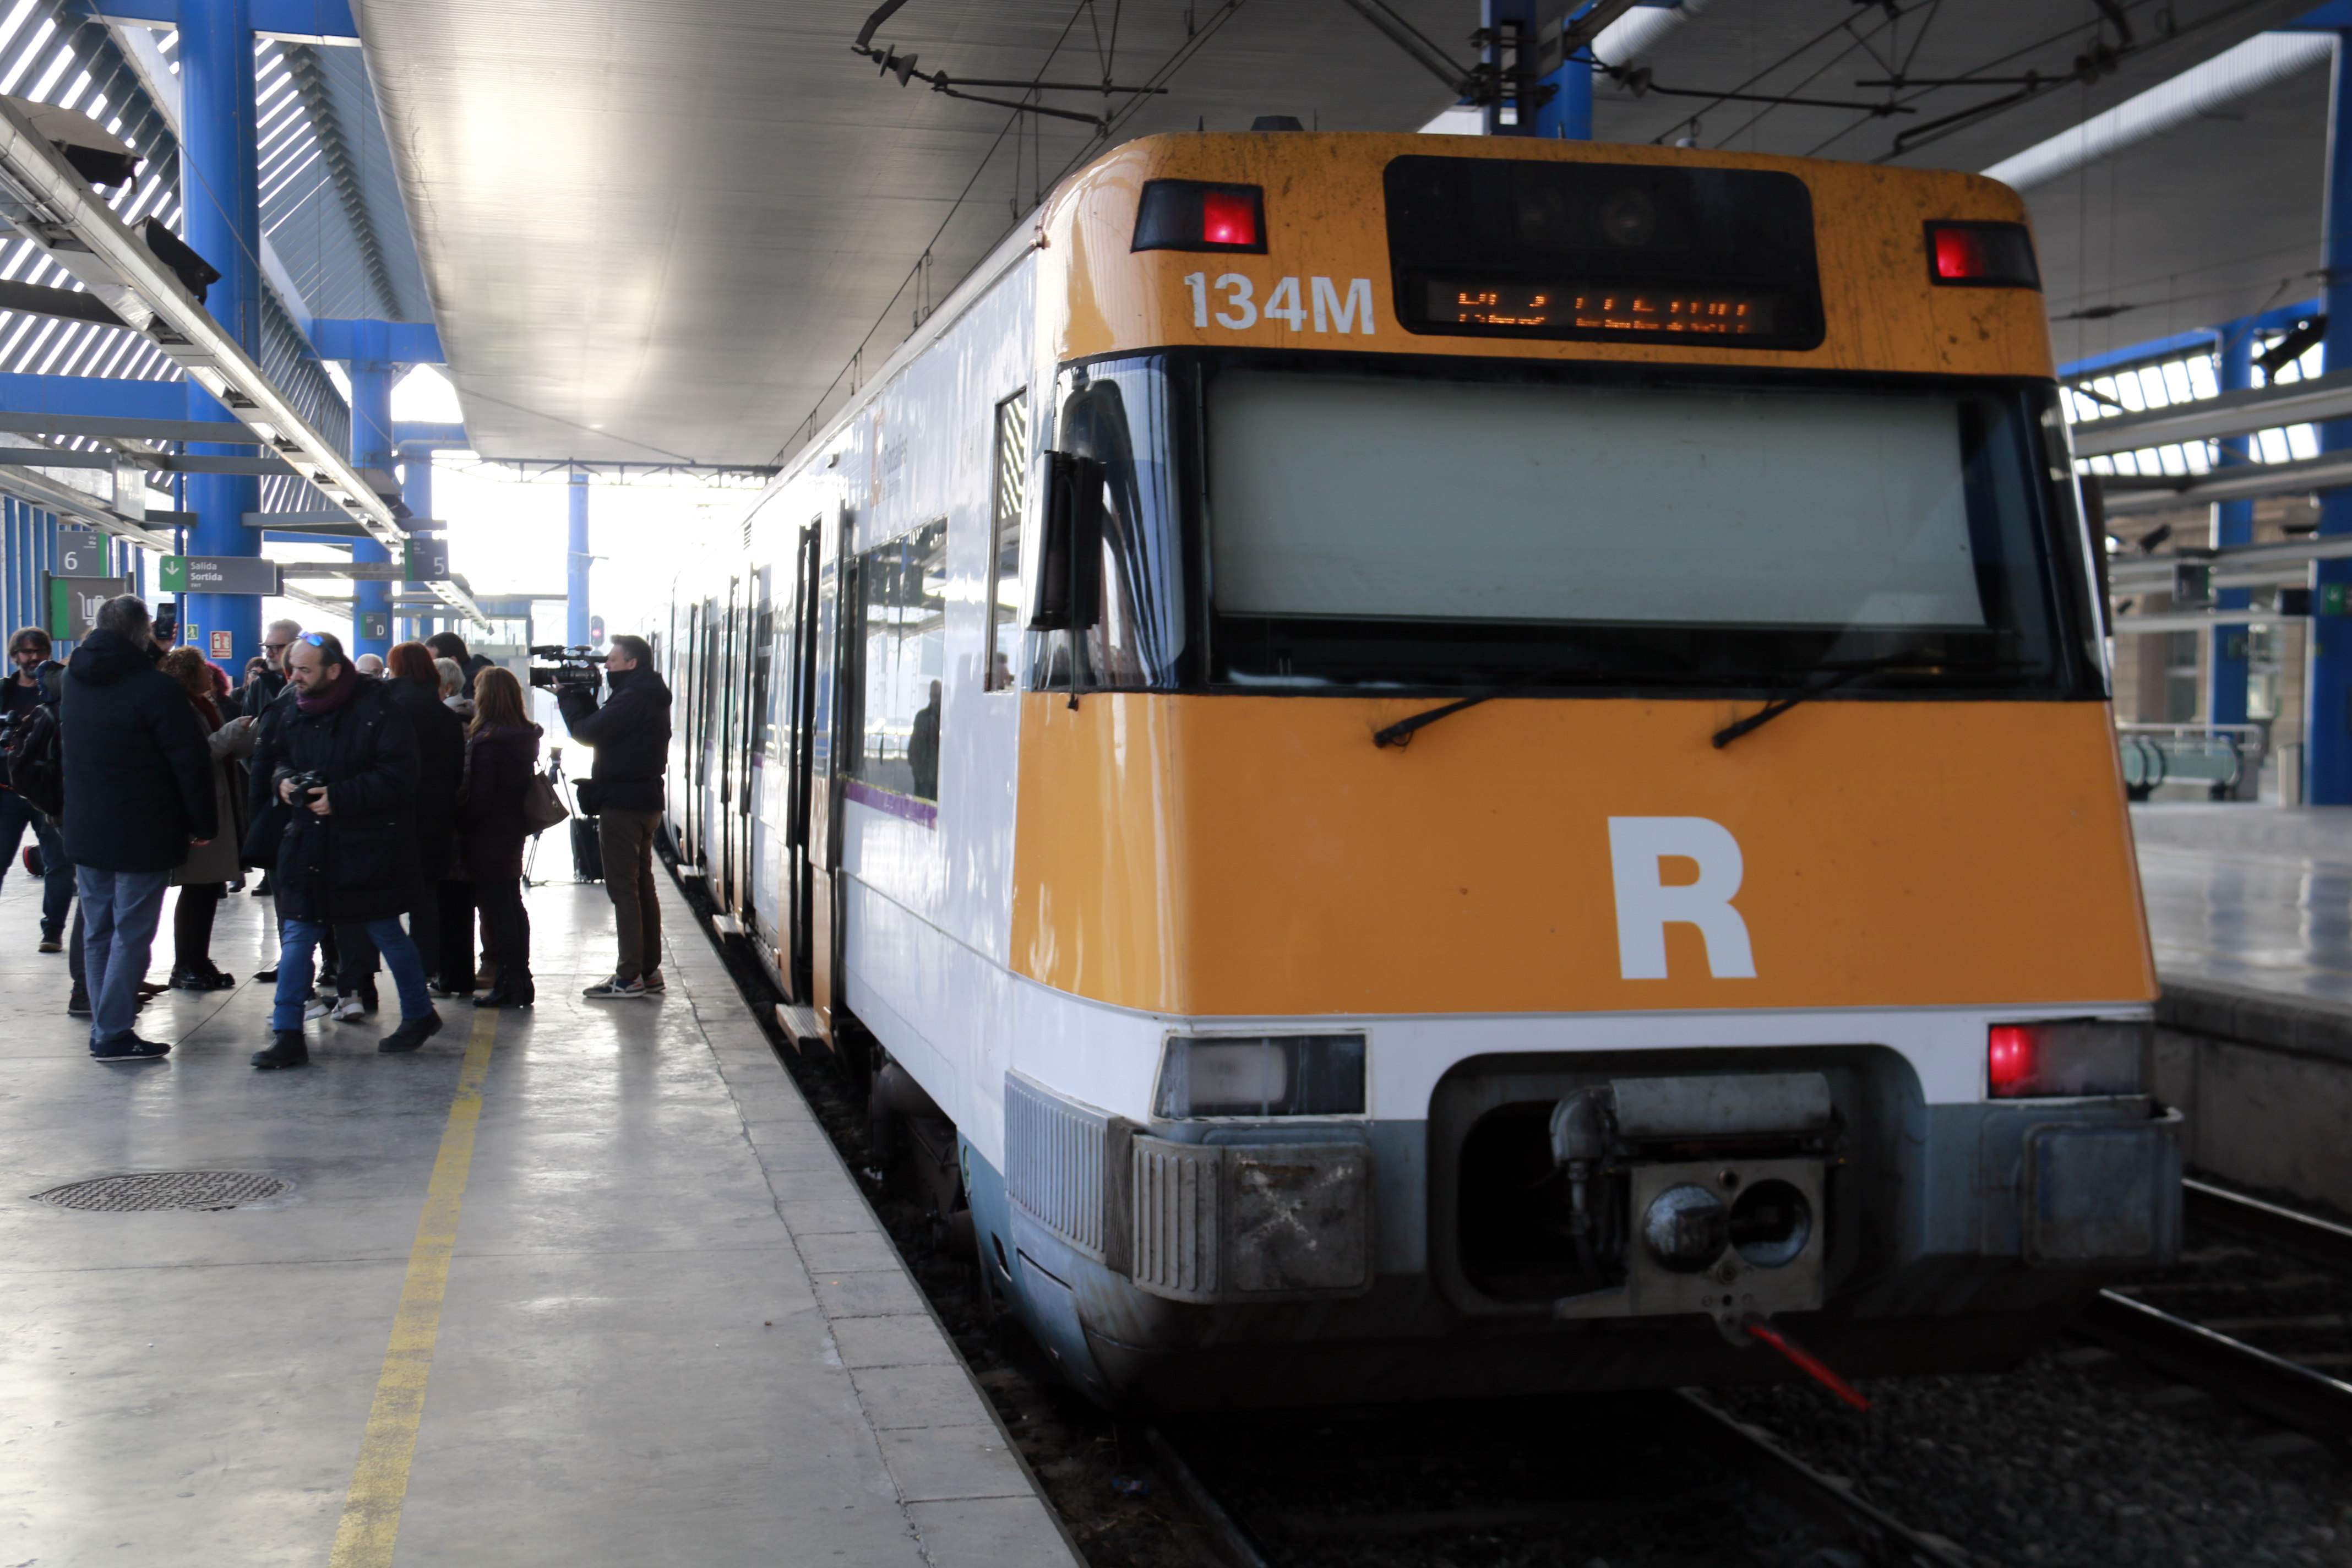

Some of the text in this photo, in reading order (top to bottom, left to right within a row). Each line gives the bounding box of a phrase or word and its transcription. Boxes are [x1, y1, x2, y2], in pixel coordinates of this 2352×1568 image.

[1184, 271, 1375, 335] 134M
[64, 551, 78, 570] 6
[190, 562, 217, 570] Salida
[433, 556, 445, 575] 5
[190, 572, 223, 581] Sortida
[377, 624, 385, 636] D
[1607, 816, 1757, 979] R
